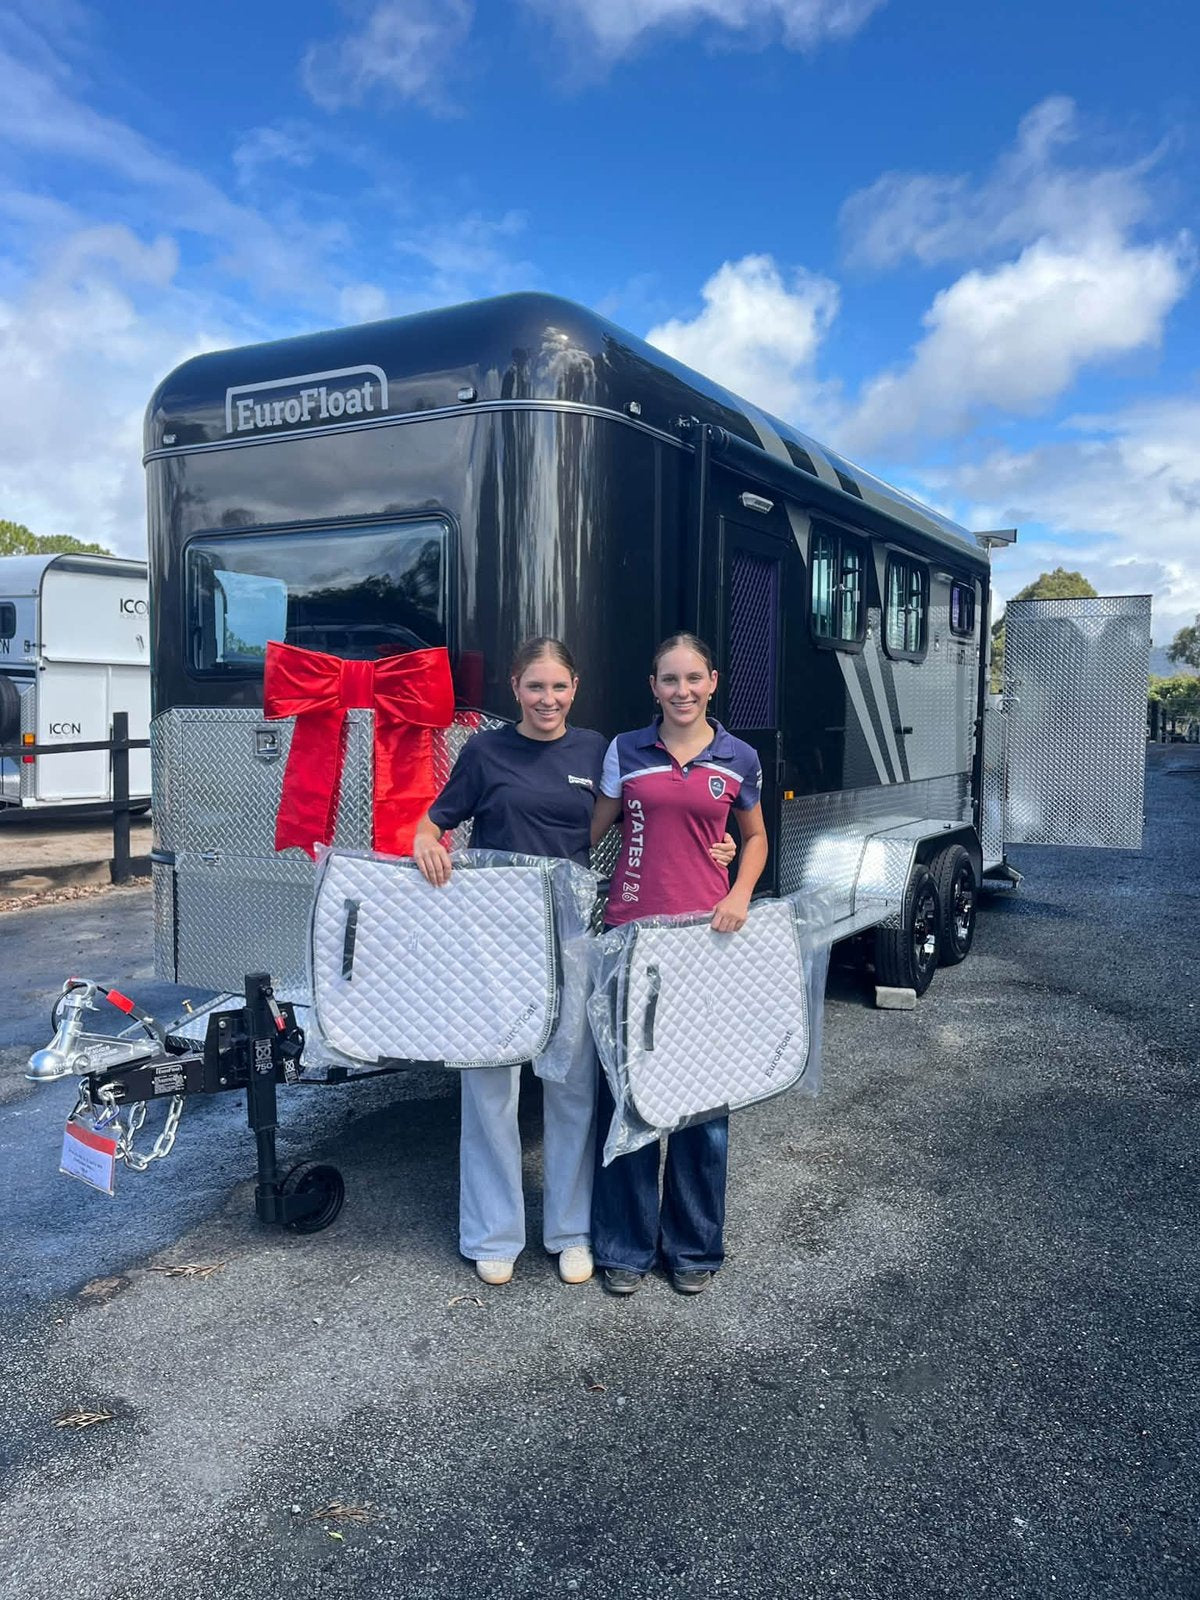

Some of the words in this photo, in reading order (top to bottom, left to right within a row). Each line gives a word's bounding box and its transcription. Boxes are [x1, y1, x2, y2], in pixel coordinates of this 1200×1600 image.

[237, 381, 374, 431] EuroFloat
[120, 598, 149, 615] ICO
[49, 723, 81, 735] ICON
[628, 799, 645, 868] STATES
[621, 882, 640, 902] 26
[765, 1030, 793, 1078] EuroFloat
[255, 1062, 273, 1072] 750
